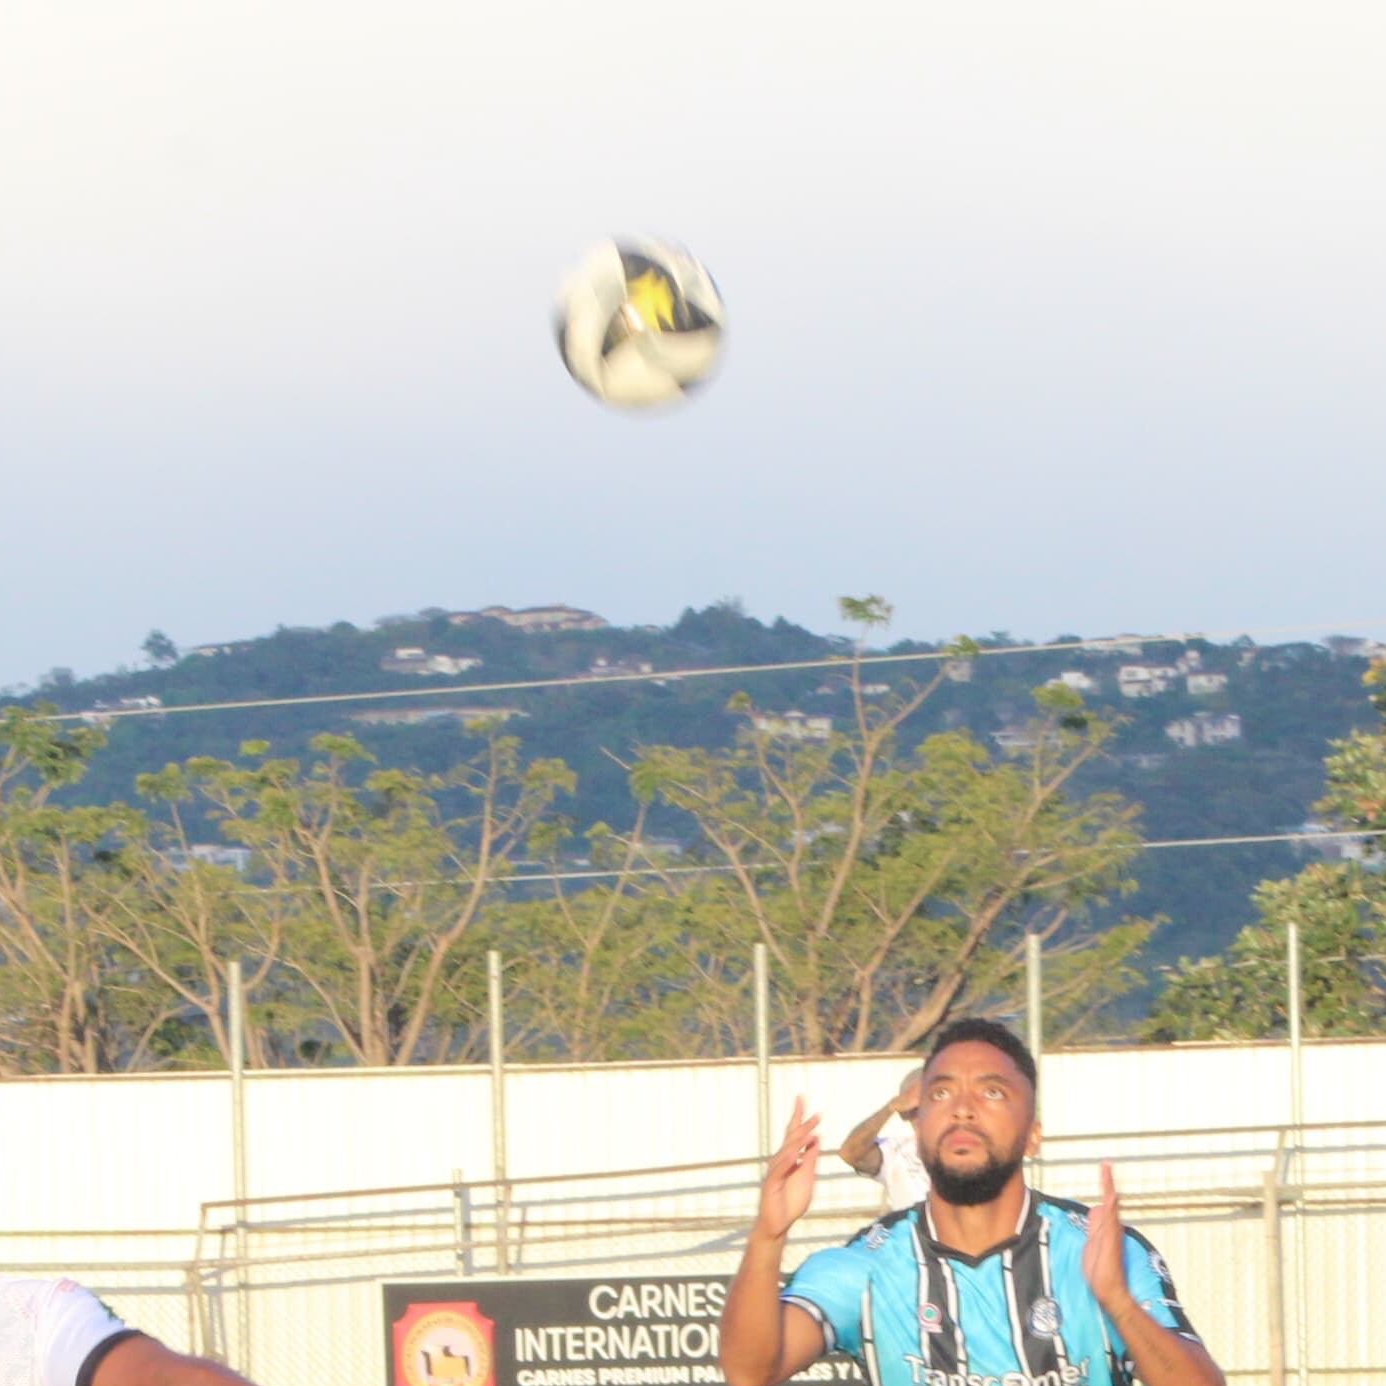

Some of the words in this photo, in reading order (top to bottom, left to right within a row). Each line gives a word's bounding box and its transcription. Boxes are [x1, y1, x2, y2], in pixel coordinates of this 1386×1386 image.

[588, 1281, 727, 1320] CARNES
[599, 1365, 690, 1385] PREMIUM
[834, 1362, 850, 1380] Y
